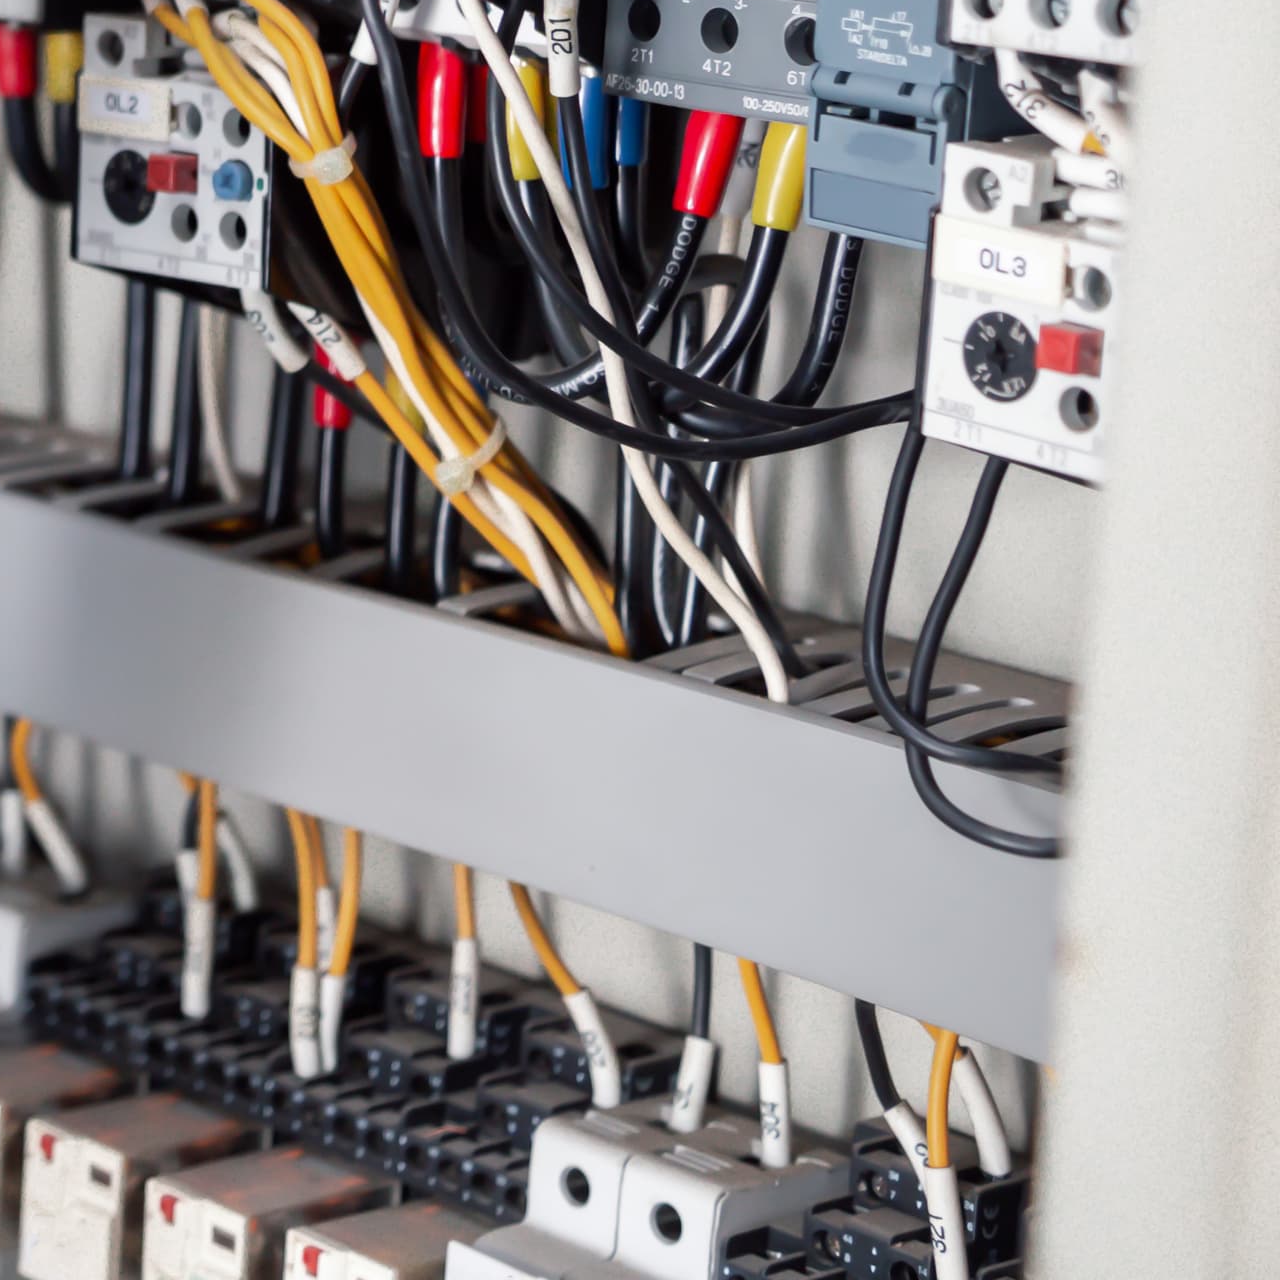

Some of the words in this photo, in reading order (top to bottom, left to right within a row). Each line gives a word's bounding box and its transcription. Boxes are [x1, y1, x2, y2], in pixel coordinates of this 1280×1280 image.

[631, 48, 653, 65] 2T1
[702, 59, 732, 77] 4T2
[786, 70, 806, 86] 6T
[105, 92, 139, 115] OL2
[658, 216, 697, 289] DODGE
[979, 247, 1027, 278] OL3
[827, 266, 856, 342] DODGE
